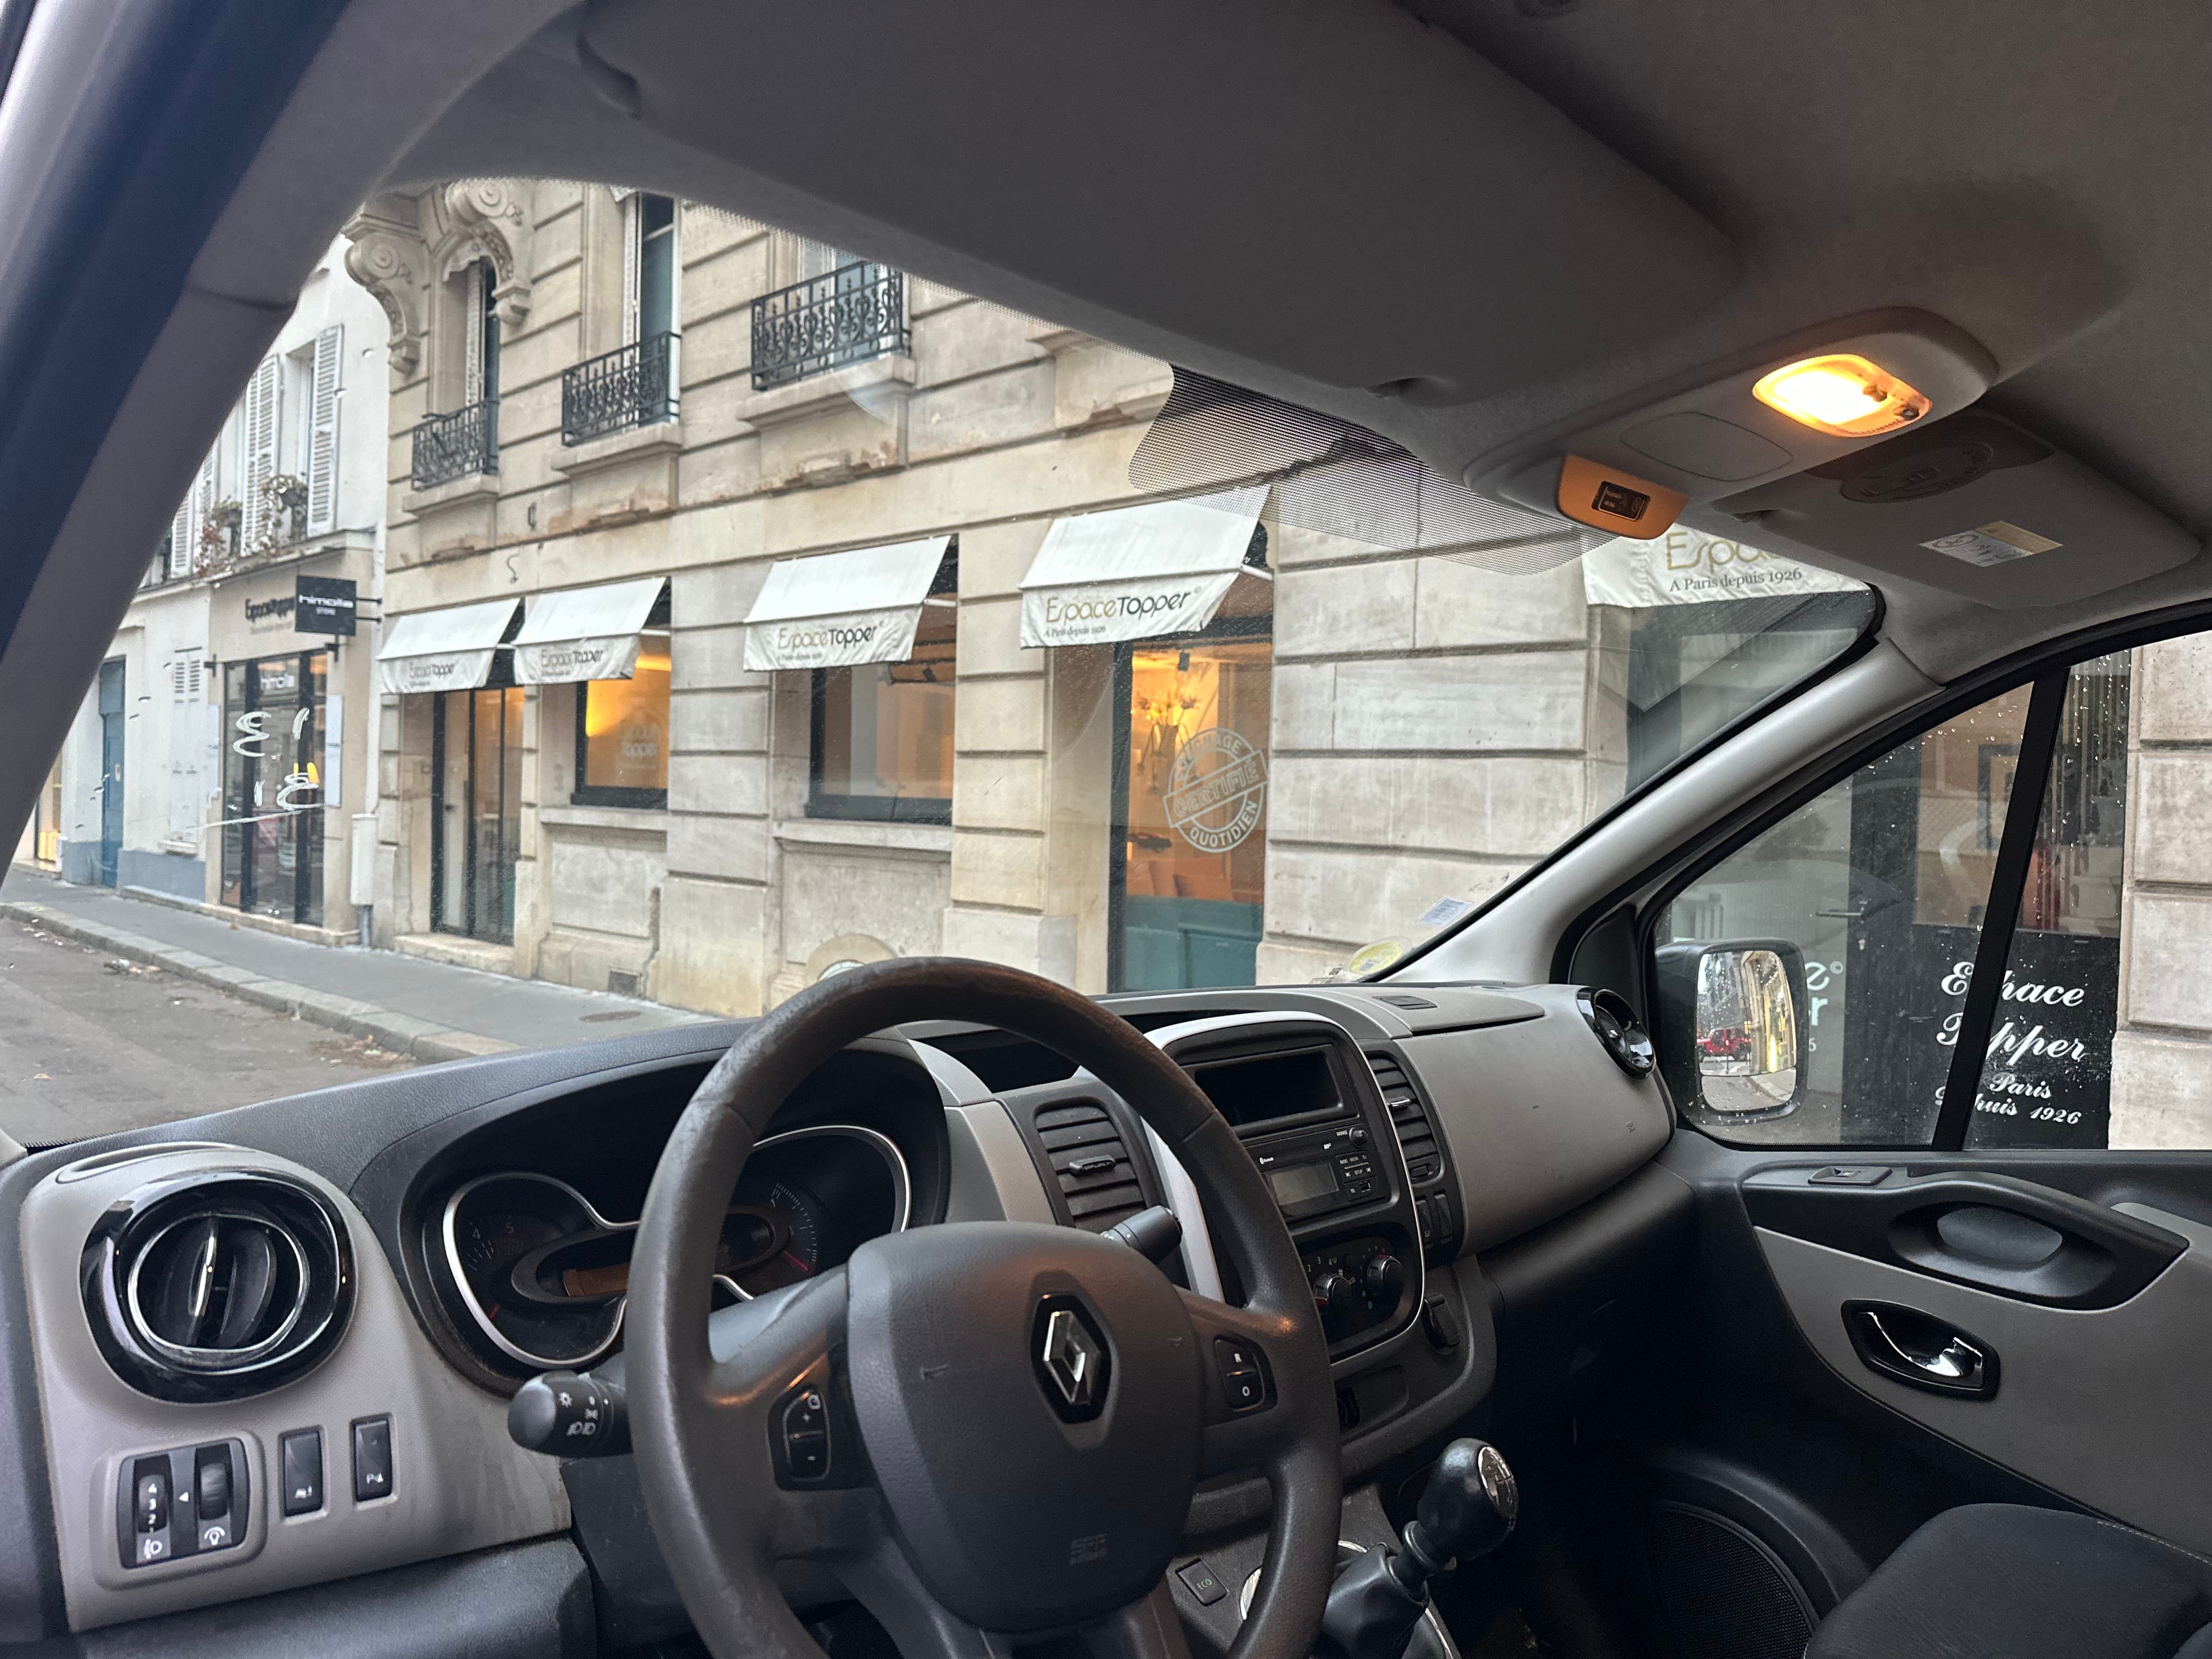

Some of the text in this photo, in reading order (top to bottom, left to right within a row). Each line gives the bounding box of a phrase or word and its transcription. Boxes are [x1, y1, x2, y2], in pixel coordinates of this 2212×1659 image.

[1669, 567, 1802, 592] A Paris depuis 1926
[1189, 800, 1257, 847] QUOTIDIEN
[1988, 1071, 2052, 1099] Paris
[2030, 1106, 2082, 1125] 1926
[472, 1228, 481, 1239] 4
[1234, 1353, 1242, 1363] R
[1197, 1578, 1212, 1589] ECO
